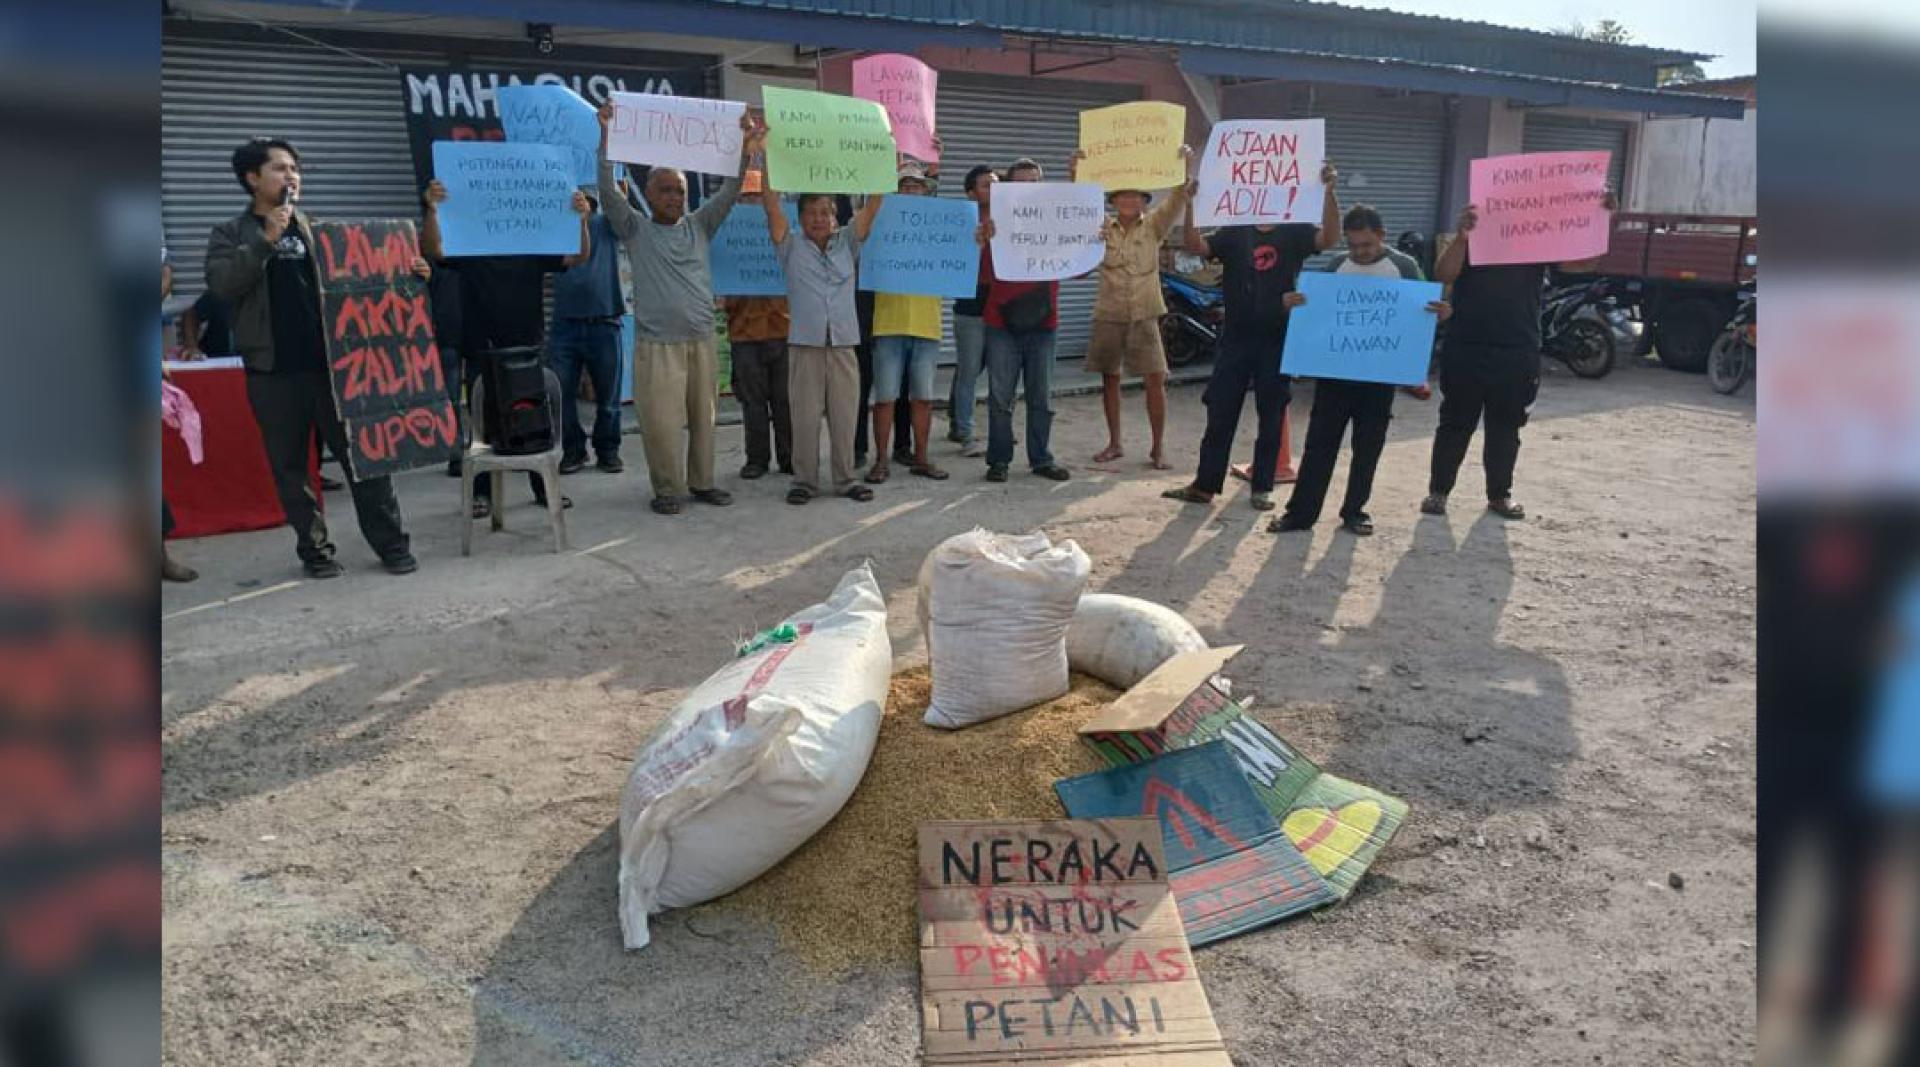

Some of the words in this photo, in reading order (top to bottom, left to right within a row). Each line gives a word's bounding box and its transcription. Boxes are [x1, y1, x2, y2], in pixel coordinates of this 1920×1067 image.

[613, 104, 738, 155] DITINDAS
[1218, 128, 1298, 157] K'JAAN
[810, 166, 858, 181] PMX
[1232, 159, 1300, 185] KENA
[1013, 206, 1042, 220] KAMI
[320, 225, 421, 283] LAWAN
[1027, 258, 1070, 272] PMX
[1336, 287, 1400, 305] LAWAN
[335, 287, 435, 340] AKTA
[1336, 307, 1397, 328] TETAP
[1329, 333, 1402, 353] LAWAN
[333, 343, 445, 401] ZALIM
[941, 838, 1159, 885] NERAKA
[983, 896, 1141, 935] UNTUK
[965, 996, 1166, 1041] PETANI
